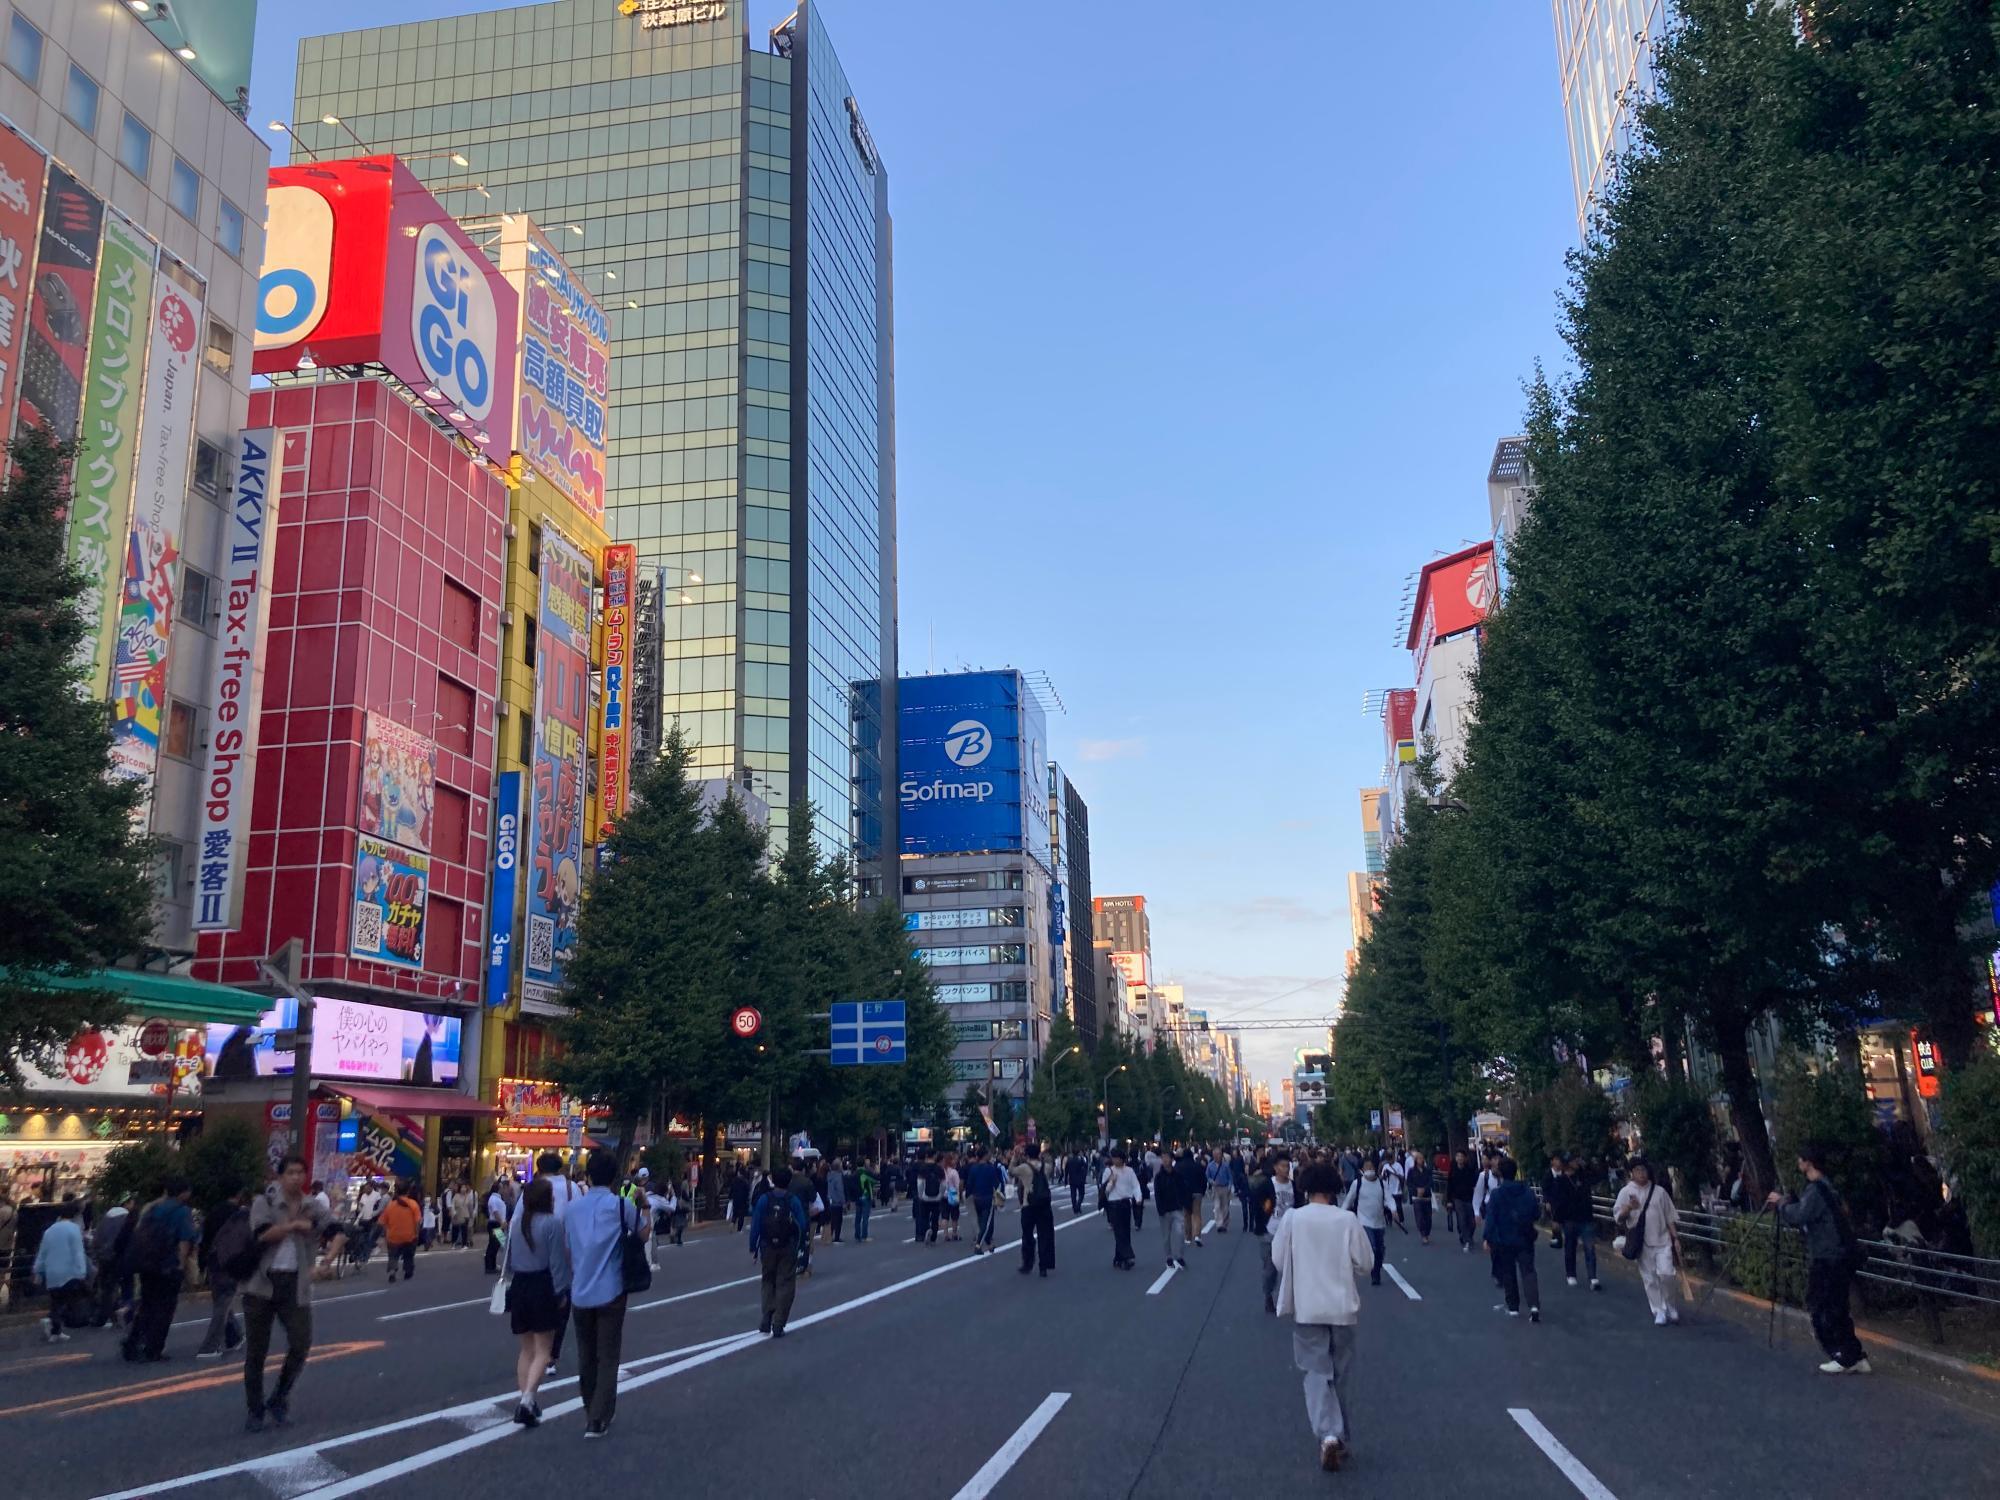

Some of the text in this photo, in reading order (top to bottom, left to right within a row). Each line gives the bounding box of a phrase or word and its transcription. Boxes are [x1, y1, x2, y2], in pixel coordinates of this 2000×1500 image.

[641, 3, 726, 29] 秋葉原ビル
[46, 225, 68, 247] MAD
[419, 304, 489, 409] GO
[527, 274, 606, 397] 激安販売
[523, 333, 606, 449] 高額買取
[149, 358, 179, 534] Japan. Tax-free Shop
[520, 394, 605, 513] Mulan
[234, 437, 267, 545] AKKY
[218, 570, 257, 723] Tax-free
[606, 608, 624, 666] ムーラン
[206, 728, 244, 823] Shop
[900, 779, 993, 803] Sofmap
[359, 839, 388, 859] ヘブバン
[387, 901, 422, 929] ガチャ
[339, 1005, 388, 1033] 僕の心の
[738, 1015, 755, 1029] 50
[864, 1003, 884, 1014] 上野
[332, 1030, 389, 1057] ヤバイやつ
